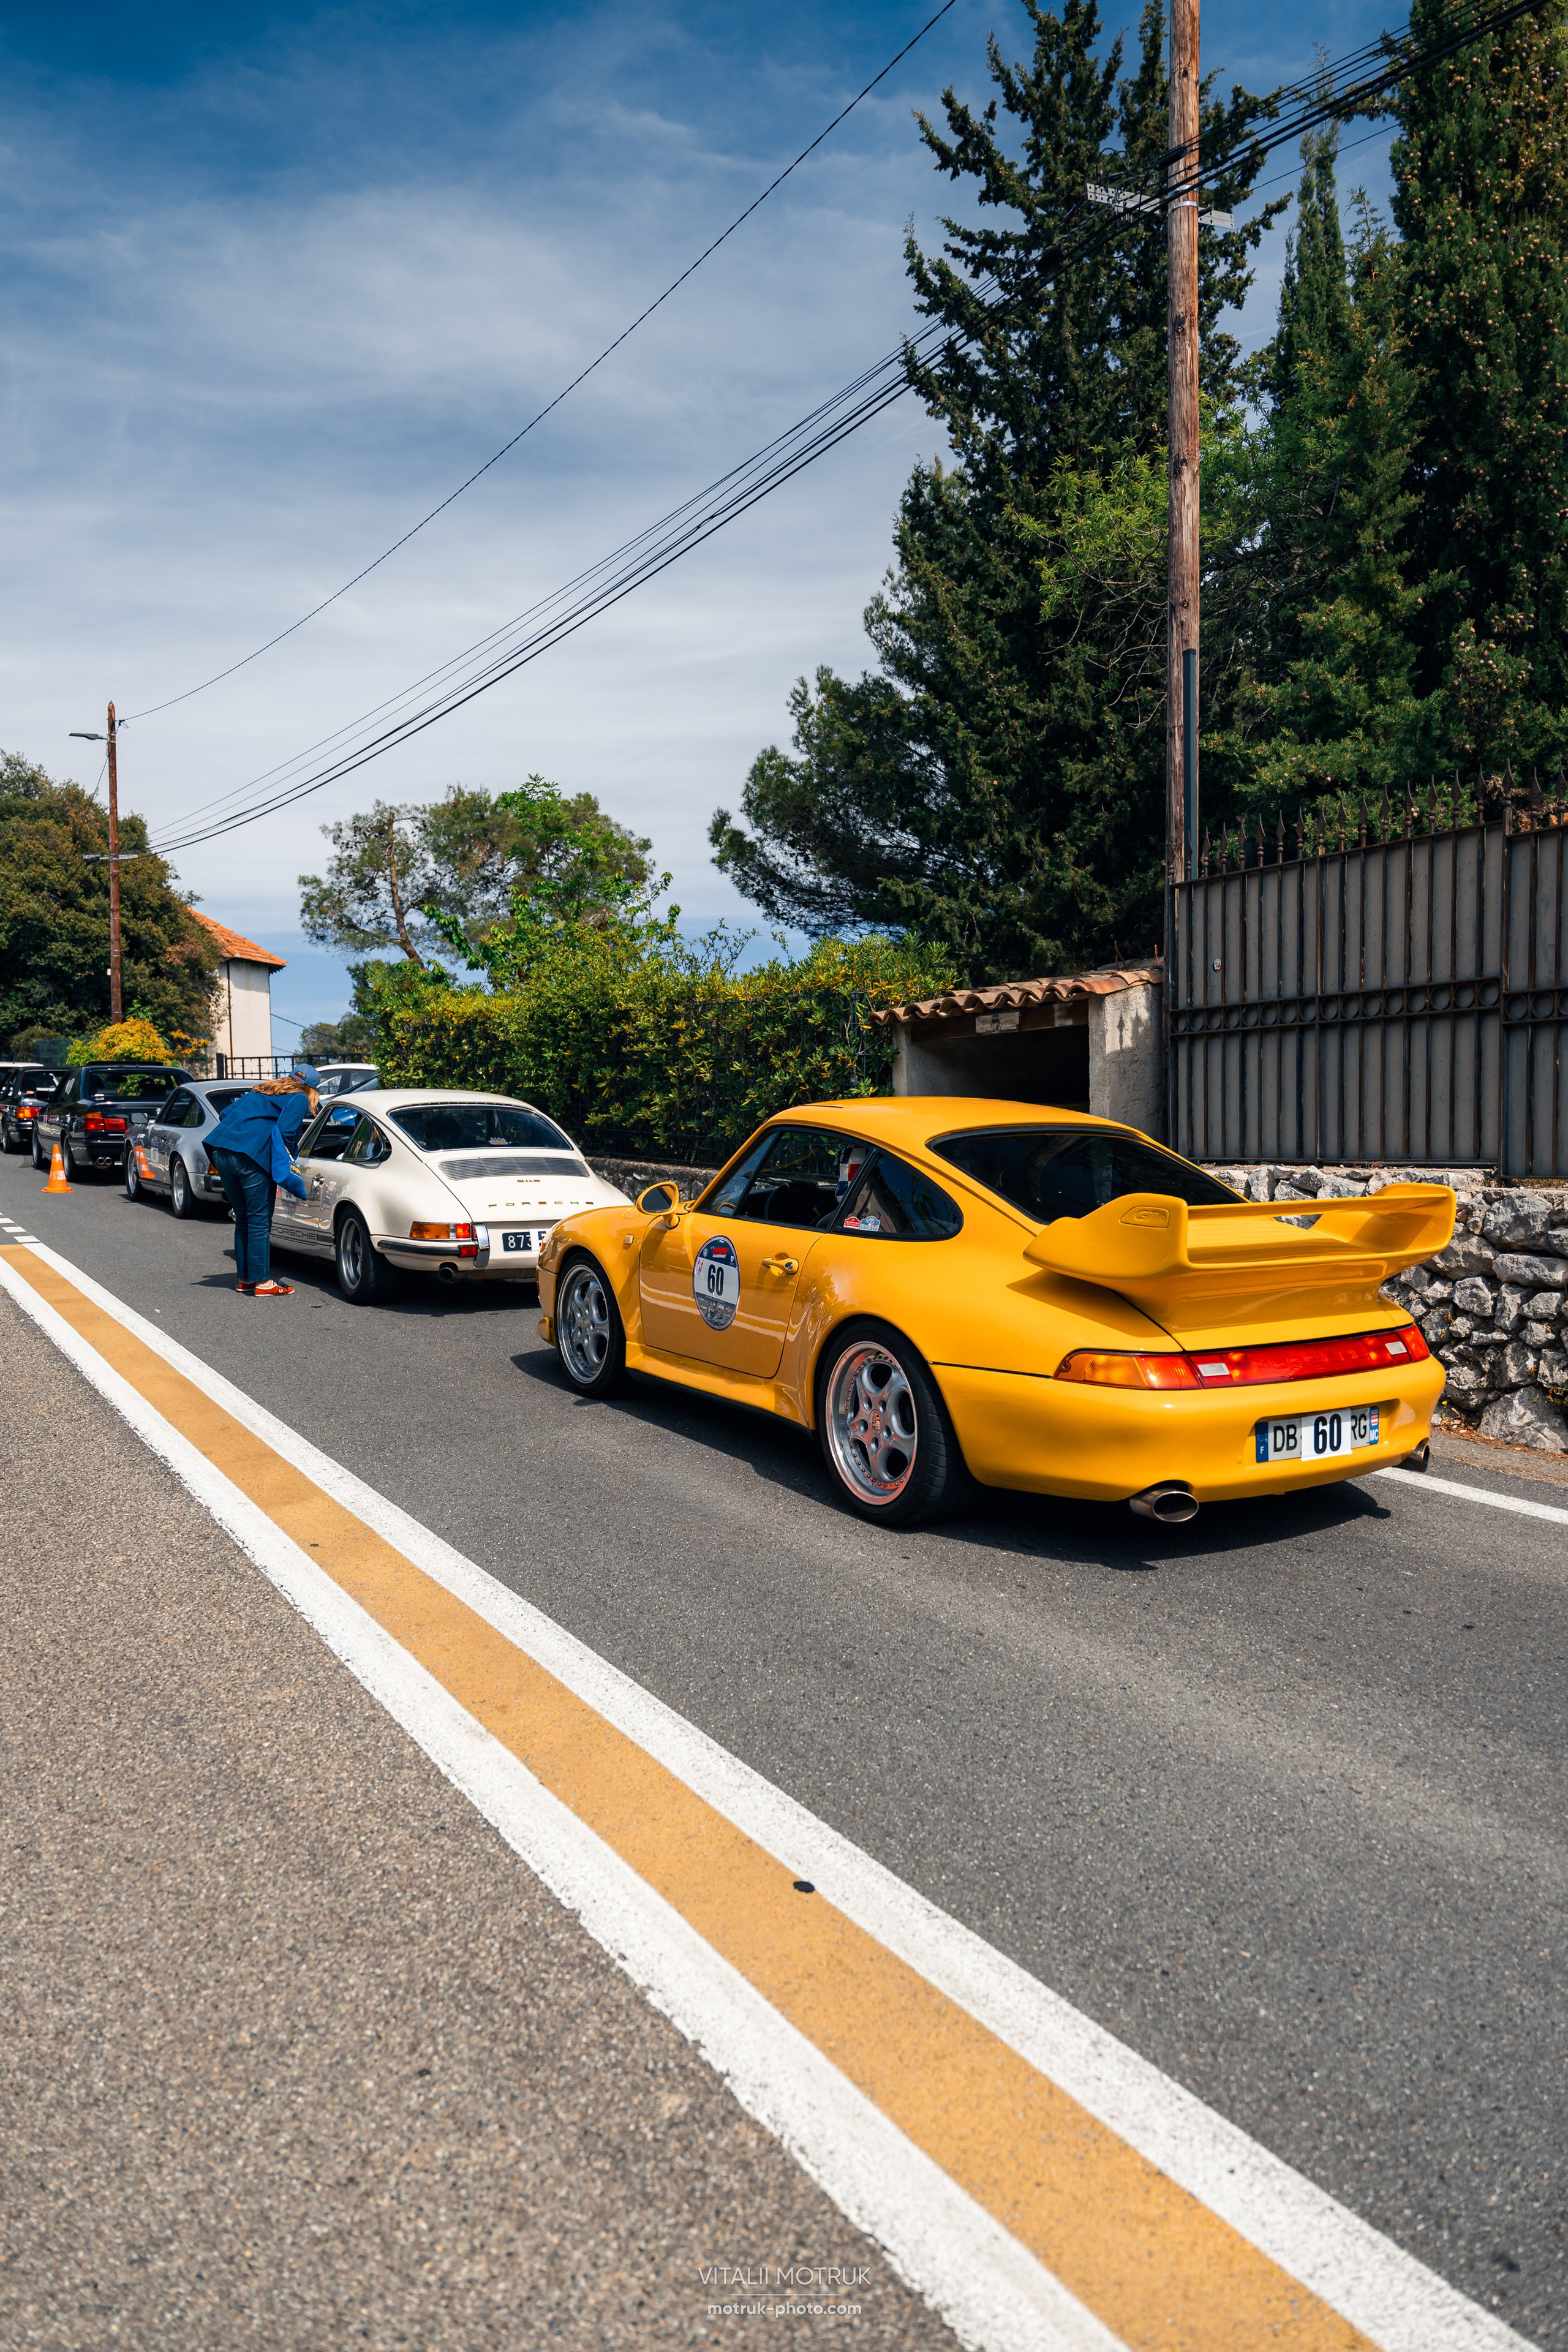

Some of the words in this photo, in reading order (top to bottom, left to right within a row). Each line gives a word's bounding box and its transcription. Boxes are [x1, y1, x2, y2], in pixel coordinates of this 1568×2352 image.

[271, 1226, 316, 1240] PORSCHE
[707, 1264, 724, 1296] 60
[1260, 1446, 1265, 1455] F
[1273, 1423, 1298, 1453] DB
[1313, 1413, 1342, 1455] 60
[1370, 1428, 1379, 1441] MC
